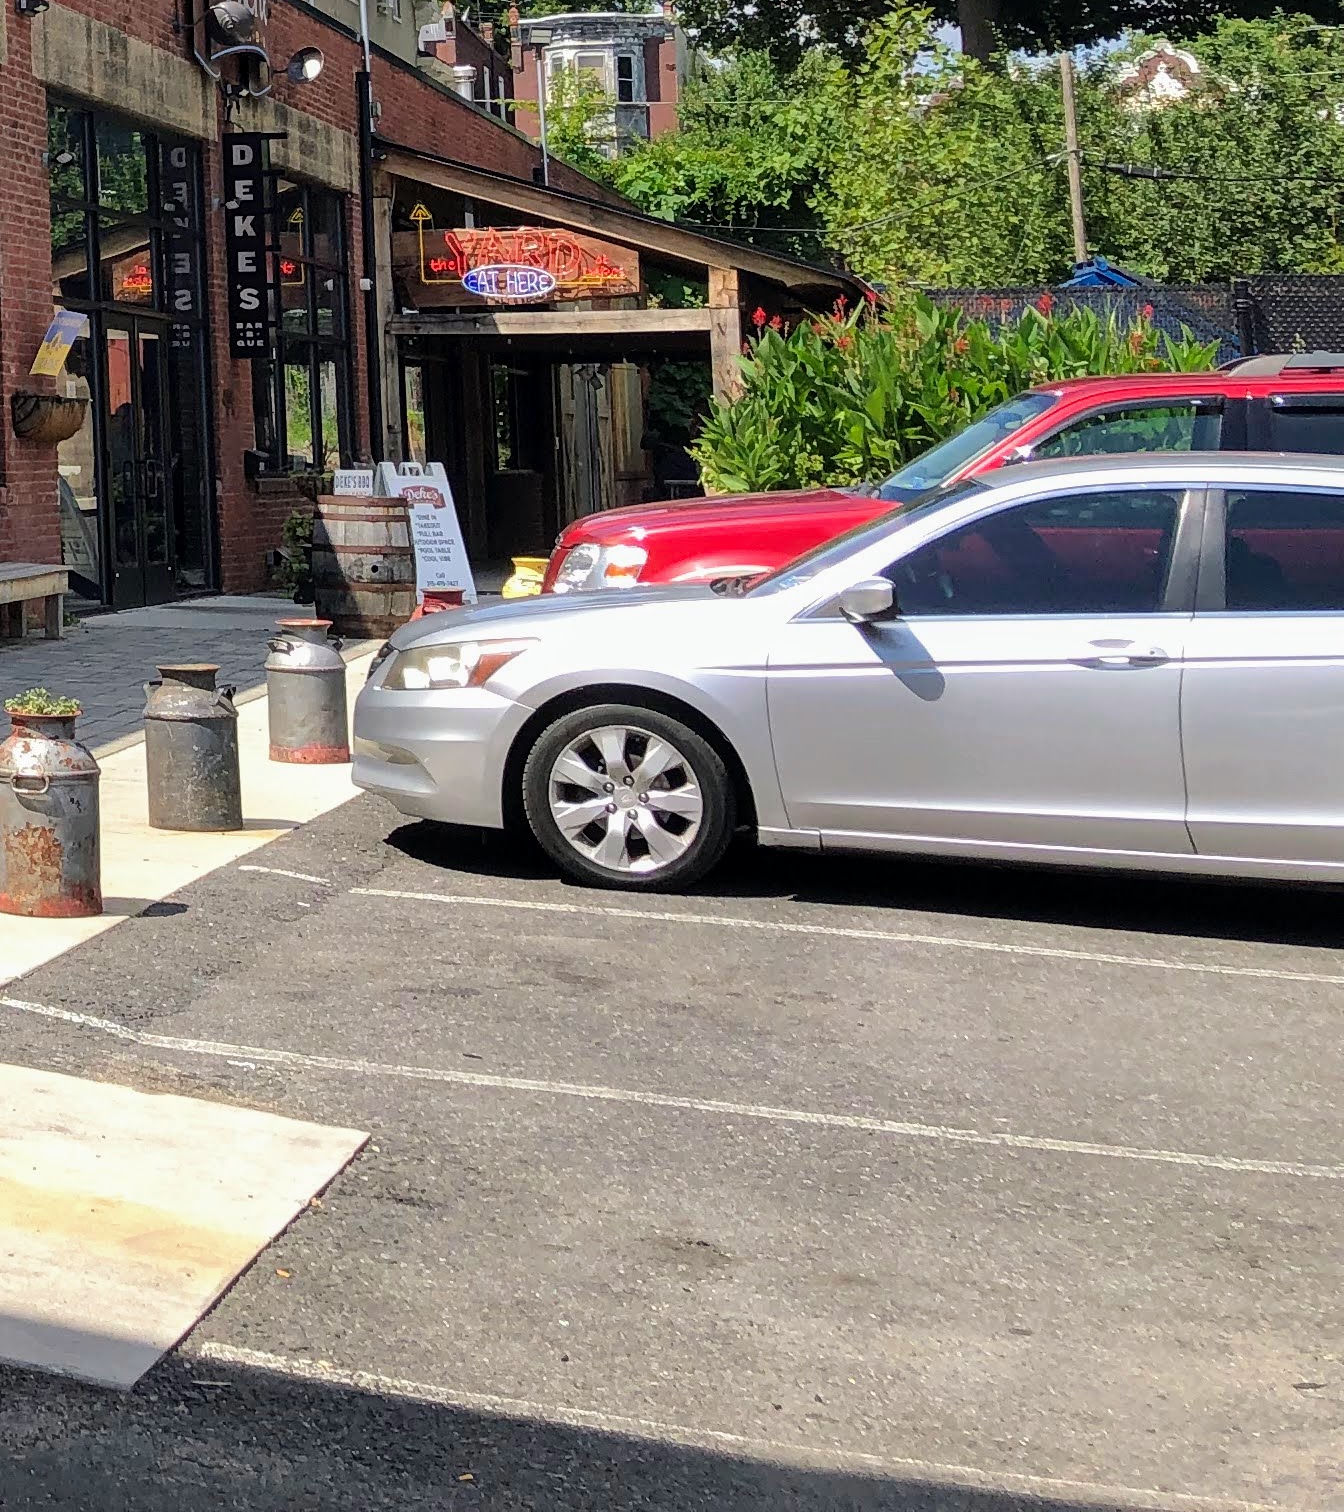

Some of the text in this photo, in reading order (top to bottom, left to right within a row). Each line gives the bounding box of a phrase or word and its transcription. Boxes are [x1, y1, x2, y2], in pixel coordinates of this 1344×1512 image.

[430, 227, 580, 278] the YARD
[468, 270, 549, 293] EAT HERE
[358, 475, 370, 488] BBQ
[404, 487, 438, 501] Deke's
